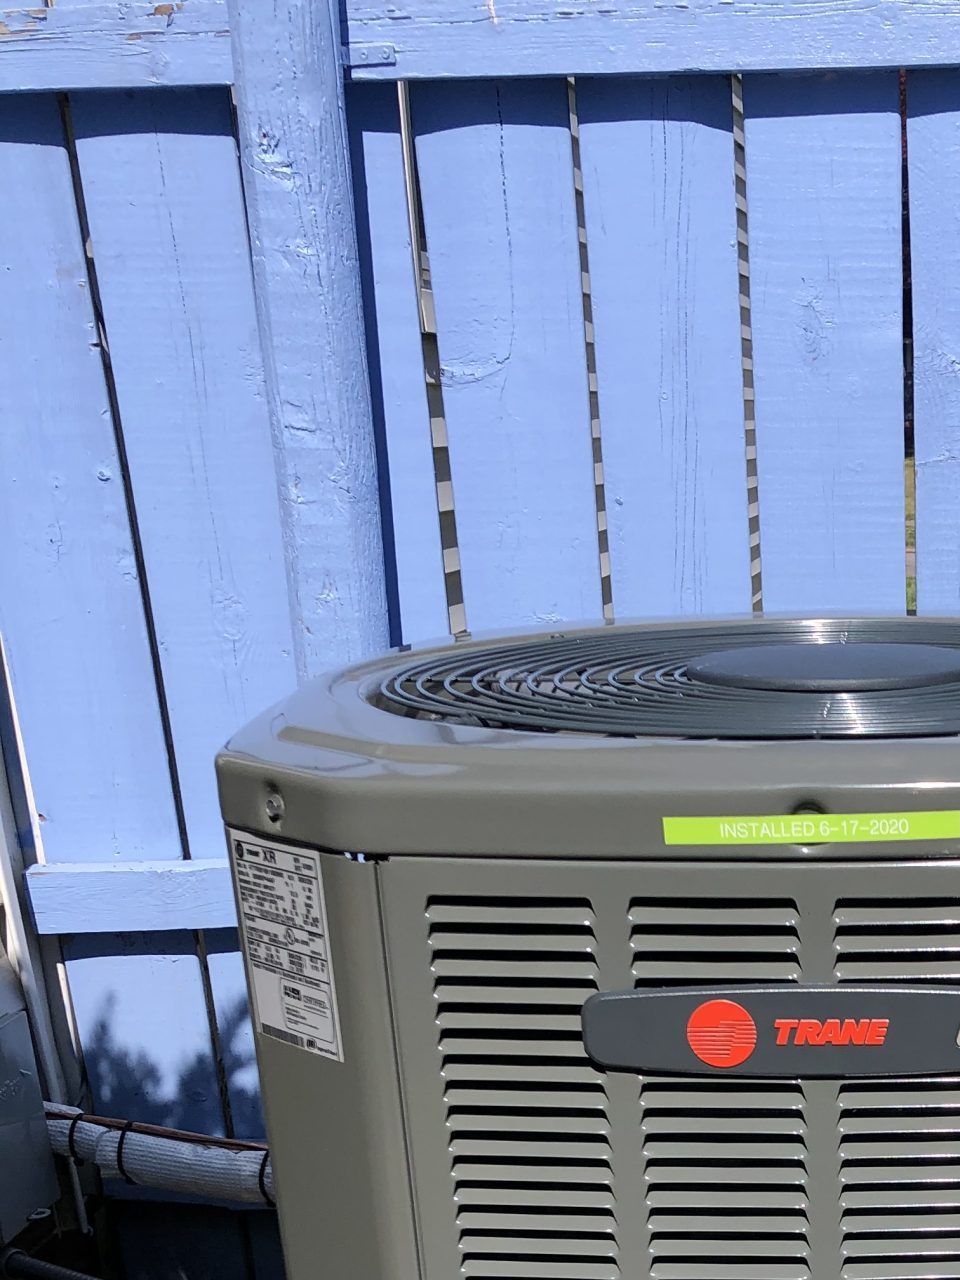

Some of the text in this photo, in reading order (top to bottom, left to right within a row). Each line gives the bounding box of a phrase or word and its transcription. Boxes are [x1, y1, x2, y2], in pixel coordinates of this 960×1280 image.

[721, 818, 909, 838] INSTALLED 6-17-2020
[262, 849, 276, 864] XR
[774, 1018, 889, 1045] TRANE
